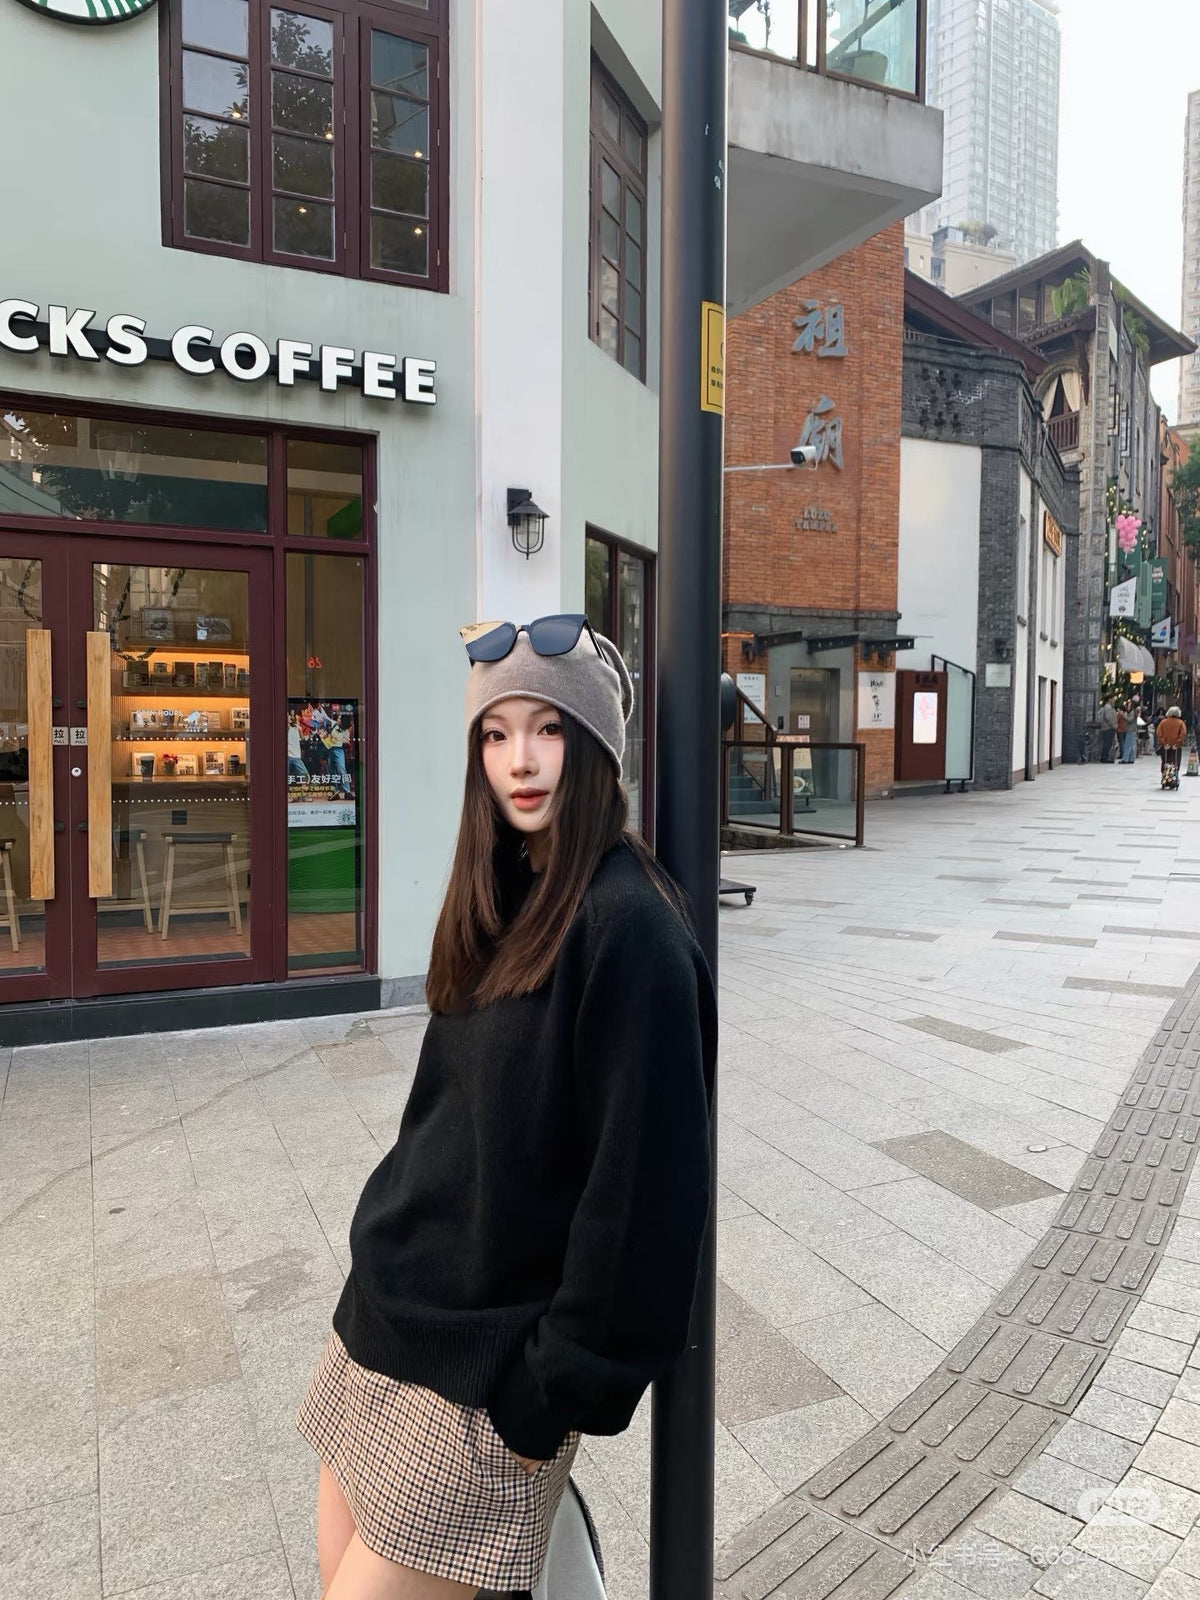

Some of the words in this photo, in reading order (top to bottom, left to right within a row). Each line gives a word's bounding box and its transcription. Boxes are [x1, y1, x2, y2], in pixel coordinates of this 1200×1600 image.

[0, 299, 147, 367] CKS
[171, 324, 437, 405] COFFEE
[54, 728, 65, 739] 拉
[75, 729, 86, 740] 拉
